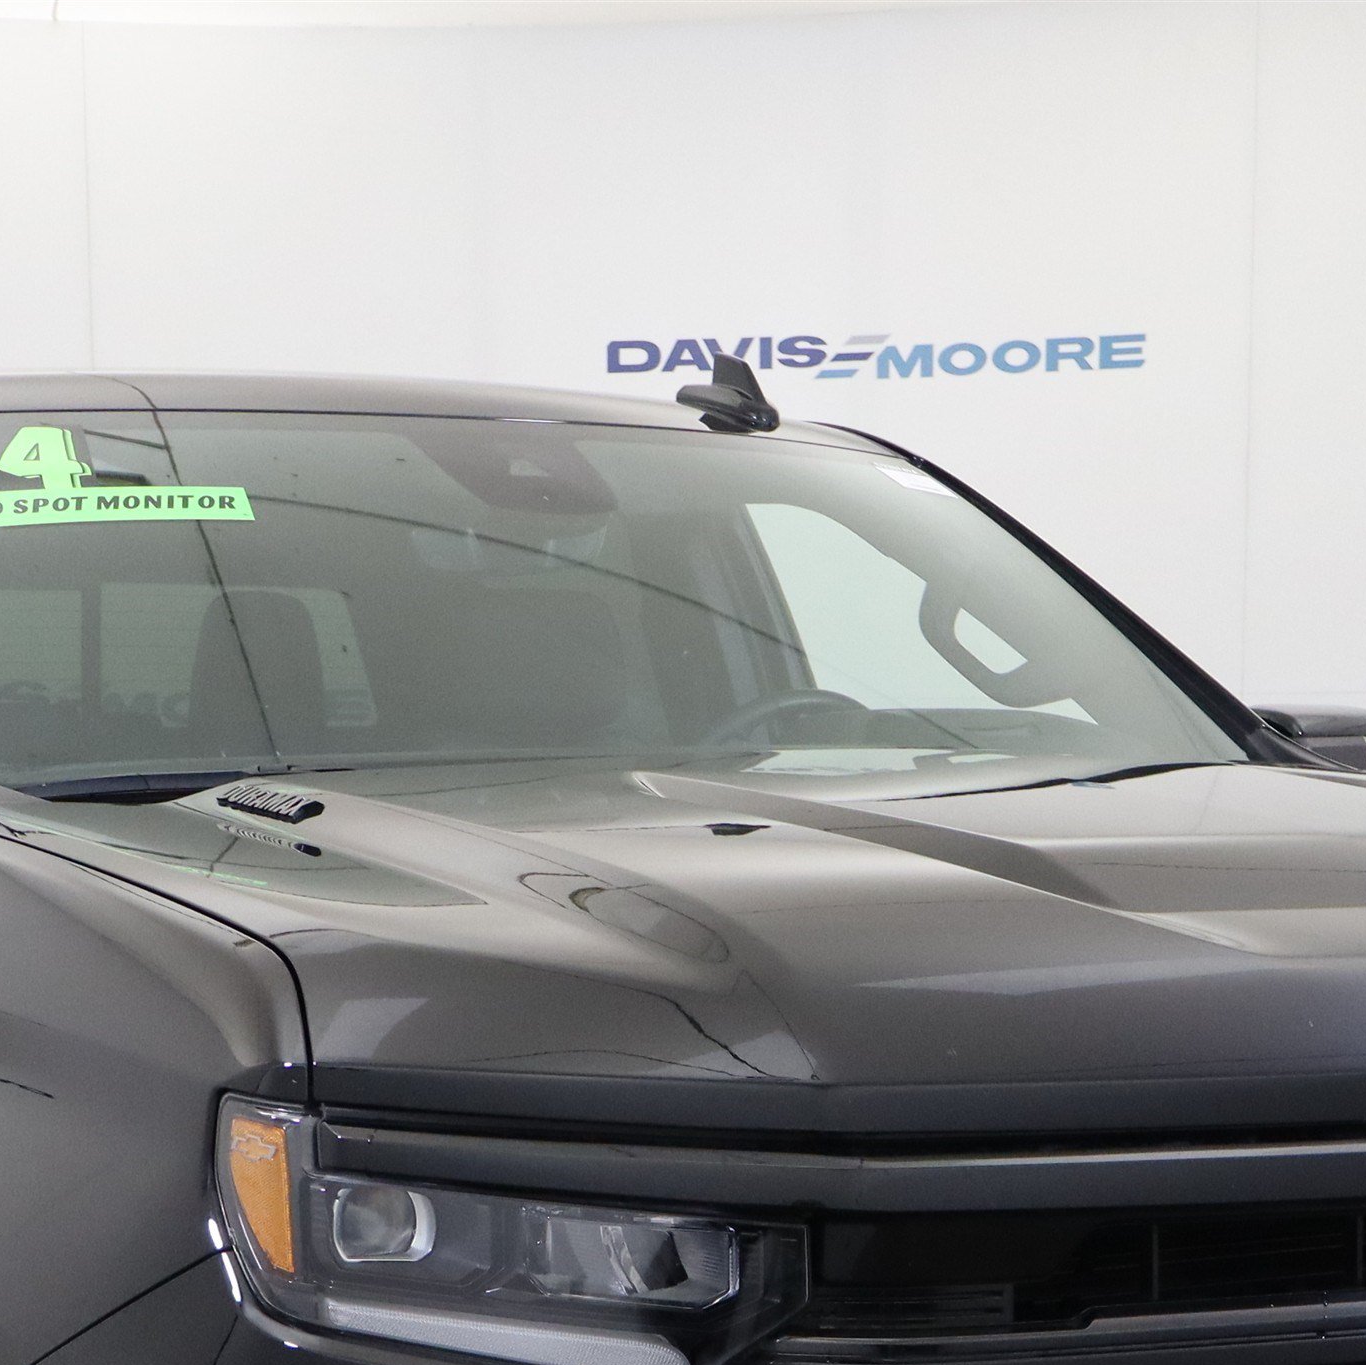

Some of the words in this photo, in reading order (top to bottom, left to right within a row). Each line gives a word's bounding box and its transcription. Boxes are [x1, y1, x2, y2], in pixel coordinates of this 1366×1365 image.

[875, 331, 1146, 380] MOORE
[13, 496, 88, 515] SPOT
[96, 494, 237, 512] MONITOR
